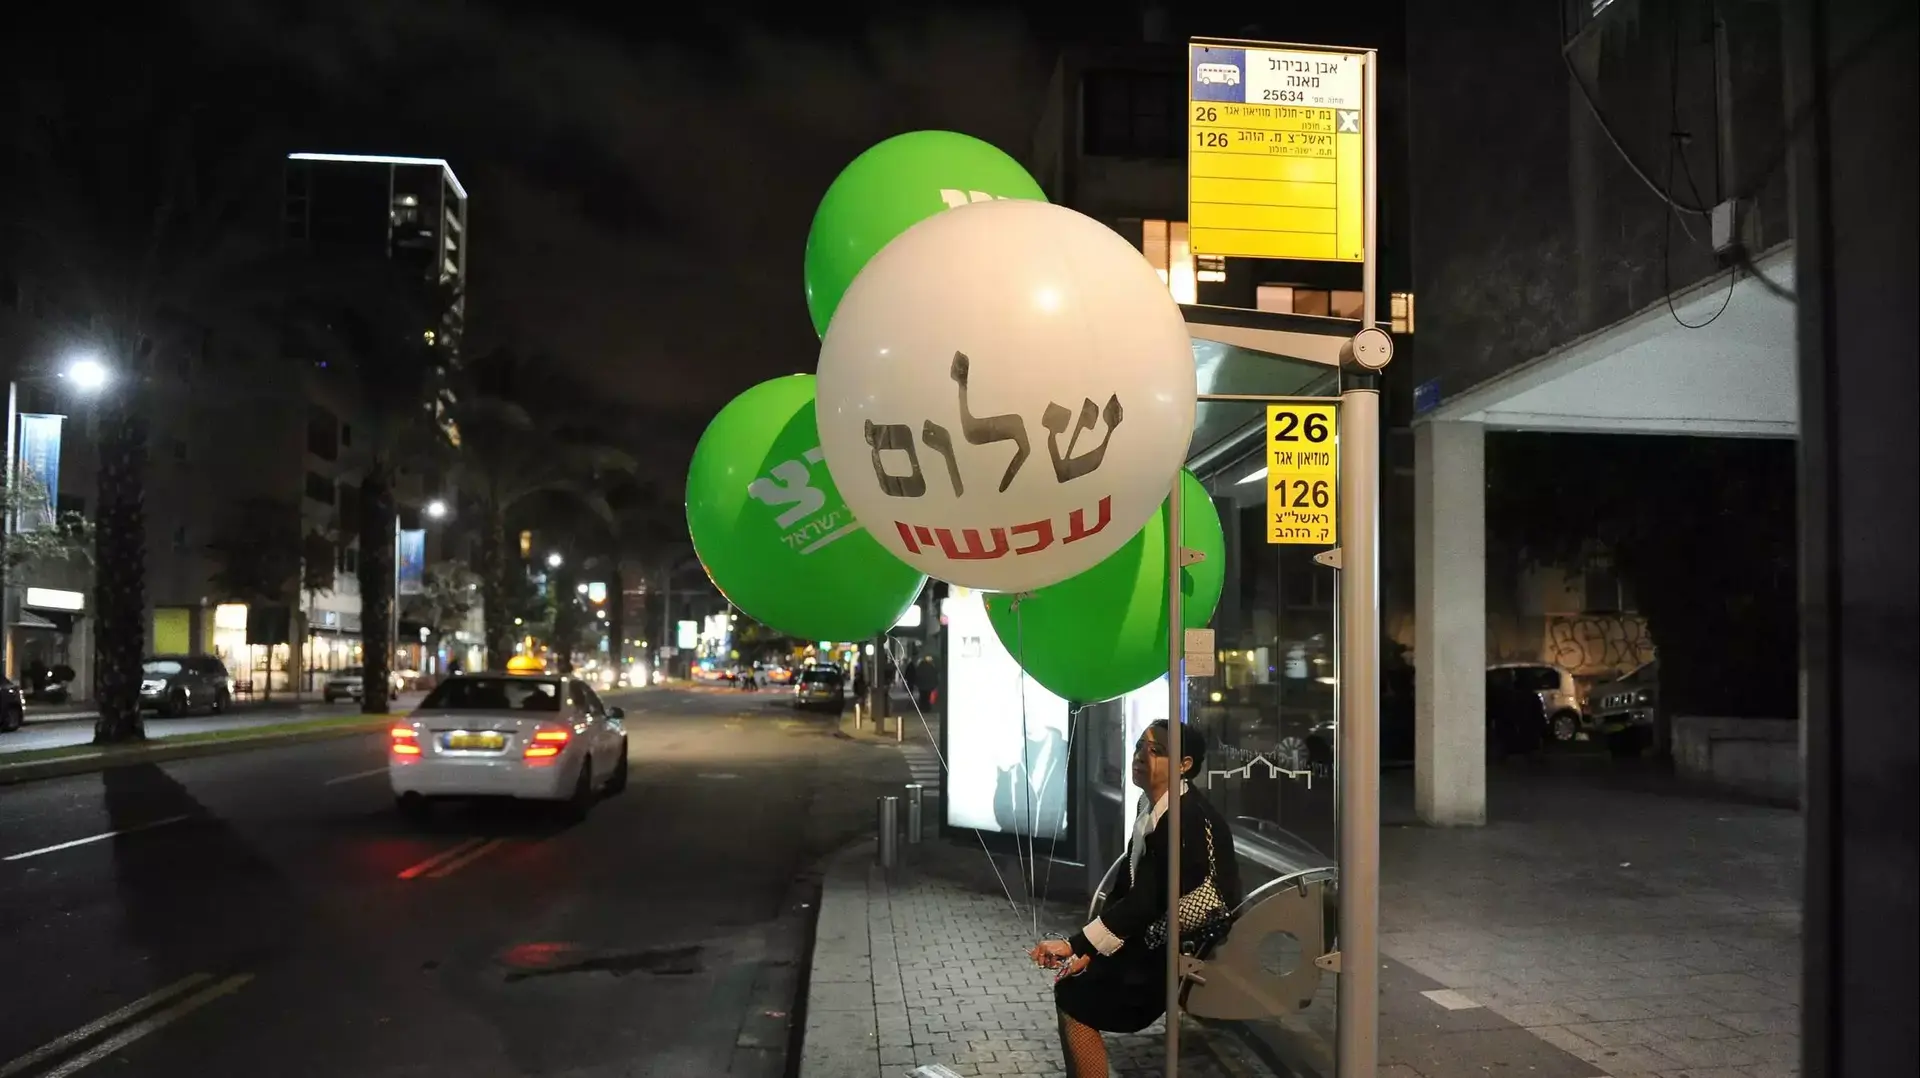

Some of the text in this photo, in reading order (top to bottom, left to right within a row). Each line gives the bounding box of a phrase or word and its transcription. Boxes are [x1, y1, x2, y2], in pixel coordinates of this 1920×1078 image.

[1268, 57, 1338, 74] אבן גבירול
[1287, 75, 1320, 88] מאנה
[1263, 89, 1304, 102] 25634
[1195, 107, 1217, 122] 26
[1224, 106, 1240, 115] אגד
[1196, 132, 1229, 147] 126
[1238, 131, 1264, 142] הזהב
[864, 350, 1124, 499] שלום
[1274, 412, 1329, 443] 26
[1274, 451, 1330, 470] מוזיאון אגד
[1274, 480, 1329, 508] 126
[894, 495, 1111, 560] עכשיו
[1275, 528, 1329, 541] ק. הזהב
